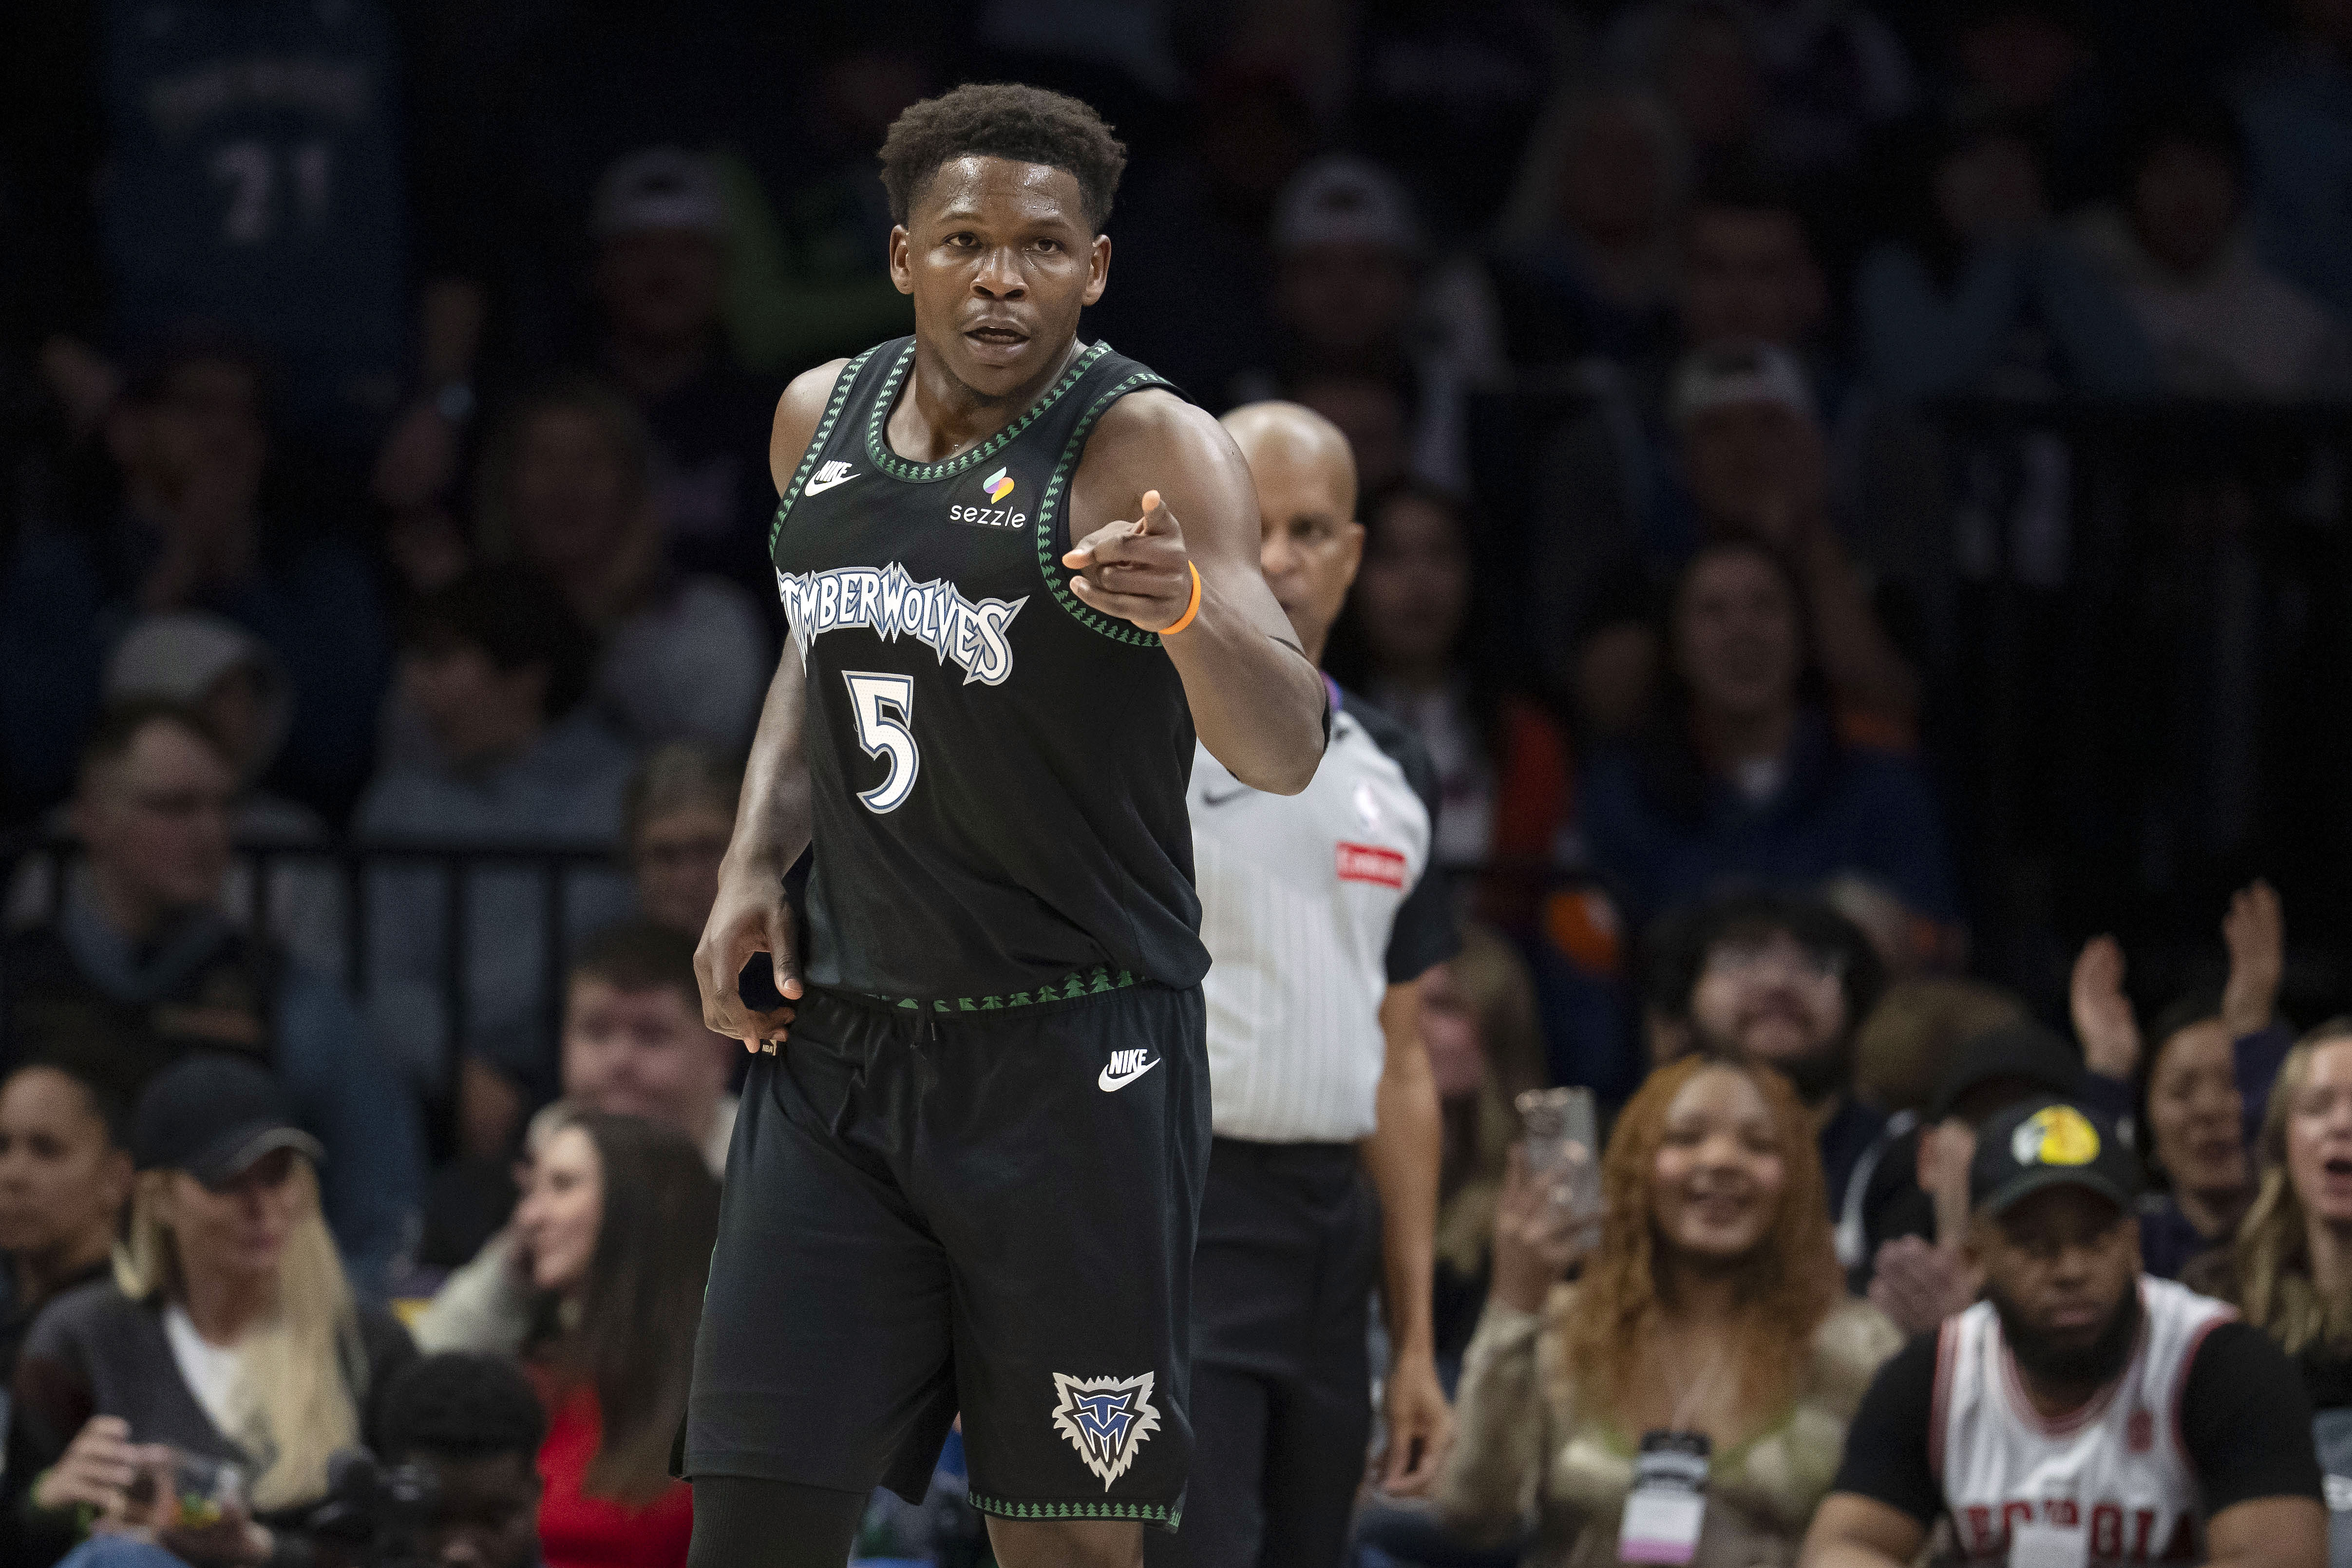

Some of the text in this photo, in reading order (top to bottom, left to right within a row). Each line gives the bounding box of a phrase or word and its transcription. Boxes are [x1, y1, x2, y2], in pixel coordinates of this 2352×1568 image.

[815, 460, 853, 482] NIKE
[950, 505, 1026, 528] sezzle
[776, 561, 1030, 686] TIMBERWOLVES
[841, 670, 919, 813] 5
[1108, 1049, 1148, 1074] NIKE
